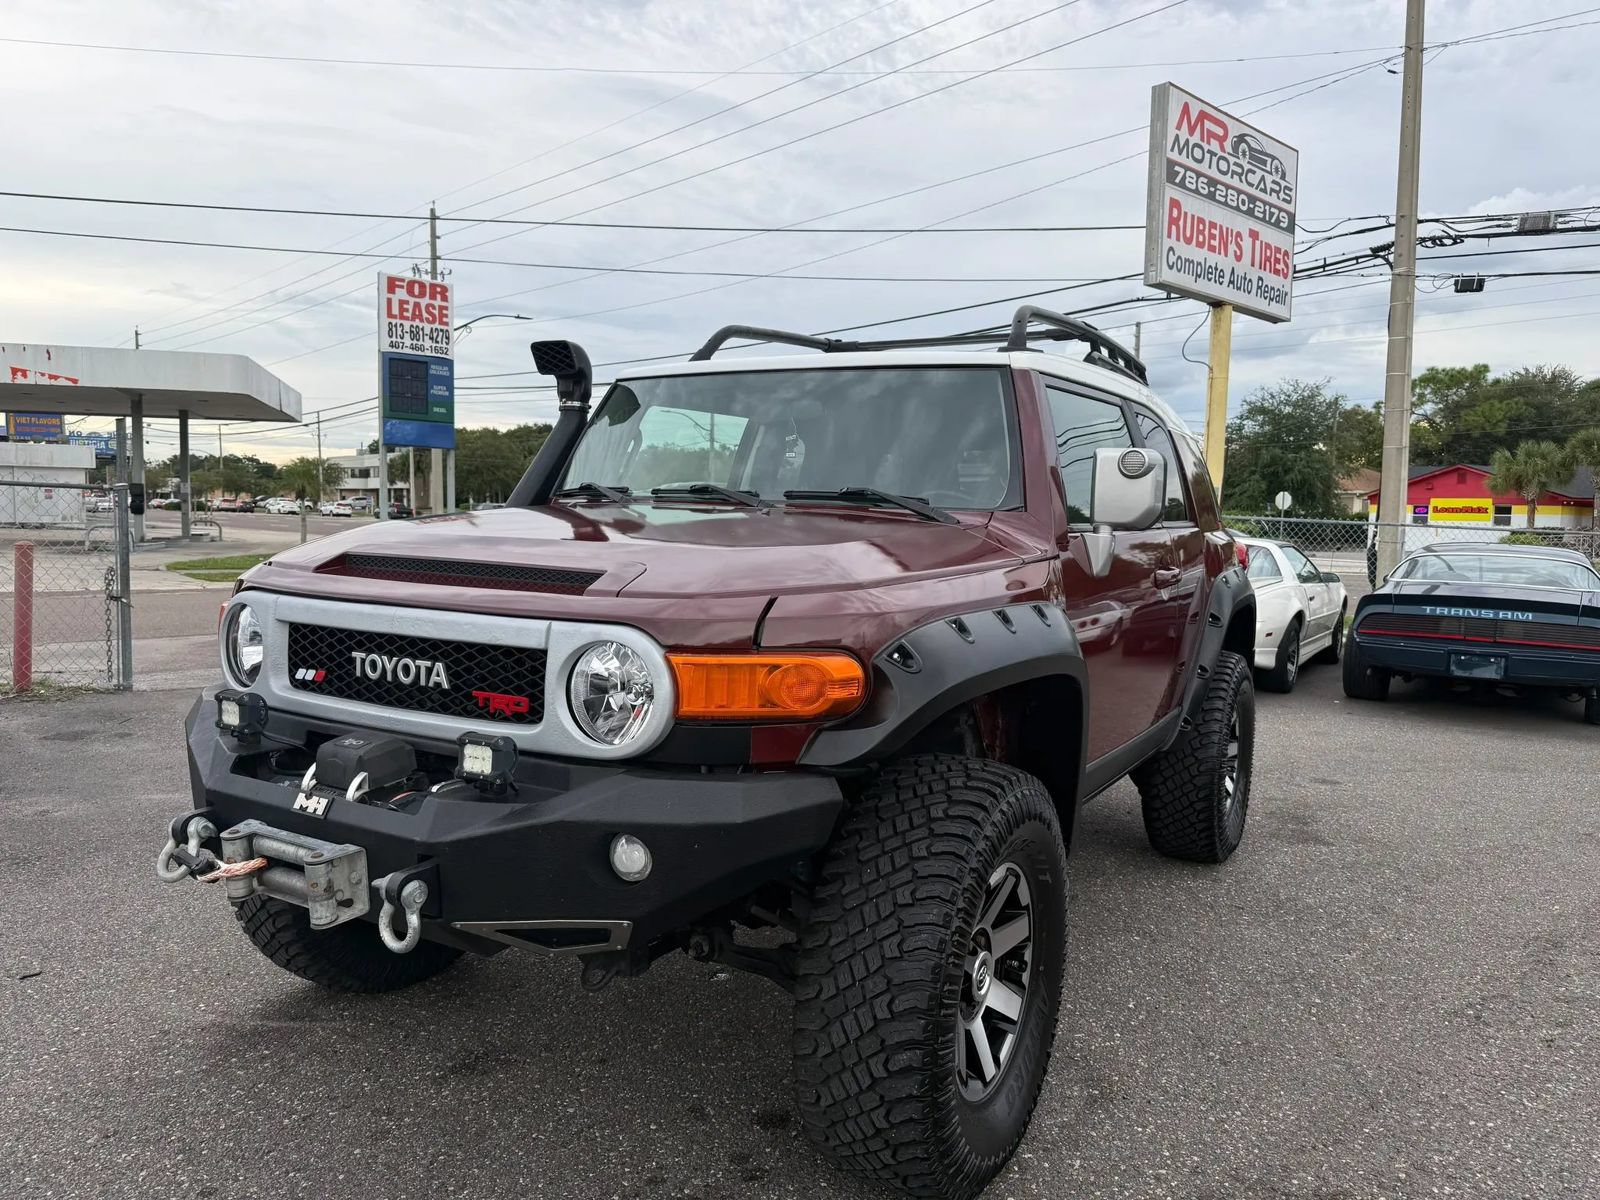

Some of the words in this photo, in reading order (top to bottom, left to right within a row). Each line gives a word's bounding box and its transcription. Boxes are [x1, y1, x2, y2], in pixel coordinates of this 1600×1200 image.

[1175, 100, 1230, 154] MR
[1170, 133, 1294, 205] MOTORCARS
[1173, 165, 1289, 228] 786-280-2179
[1166, 196, 1244, 263] RUBEN'S
[1248, 228, 1290, 280] TIRES
[386, 275, 449, 303] FOR
[1166, 246, 1226, 287] Complete
[1227, 266, 1254, 295] Auto
[1255, 275, 1289, 307] Repair
[386, 297, 450, 327] LEASE
[387, 321, 450, 346] 813-681-4279
[388, 341, 450, 356] 407-460-1652
[15, 416, 30, 424] VIET
[31, 417, 61, 425] FLAVORS
[1421, 606, 1494, 618] TRANS
[1499, 611, 1533, 620] AM
[351, 651, 450, 689] TOYOTA
[472, 690, 529, 717] TRD
